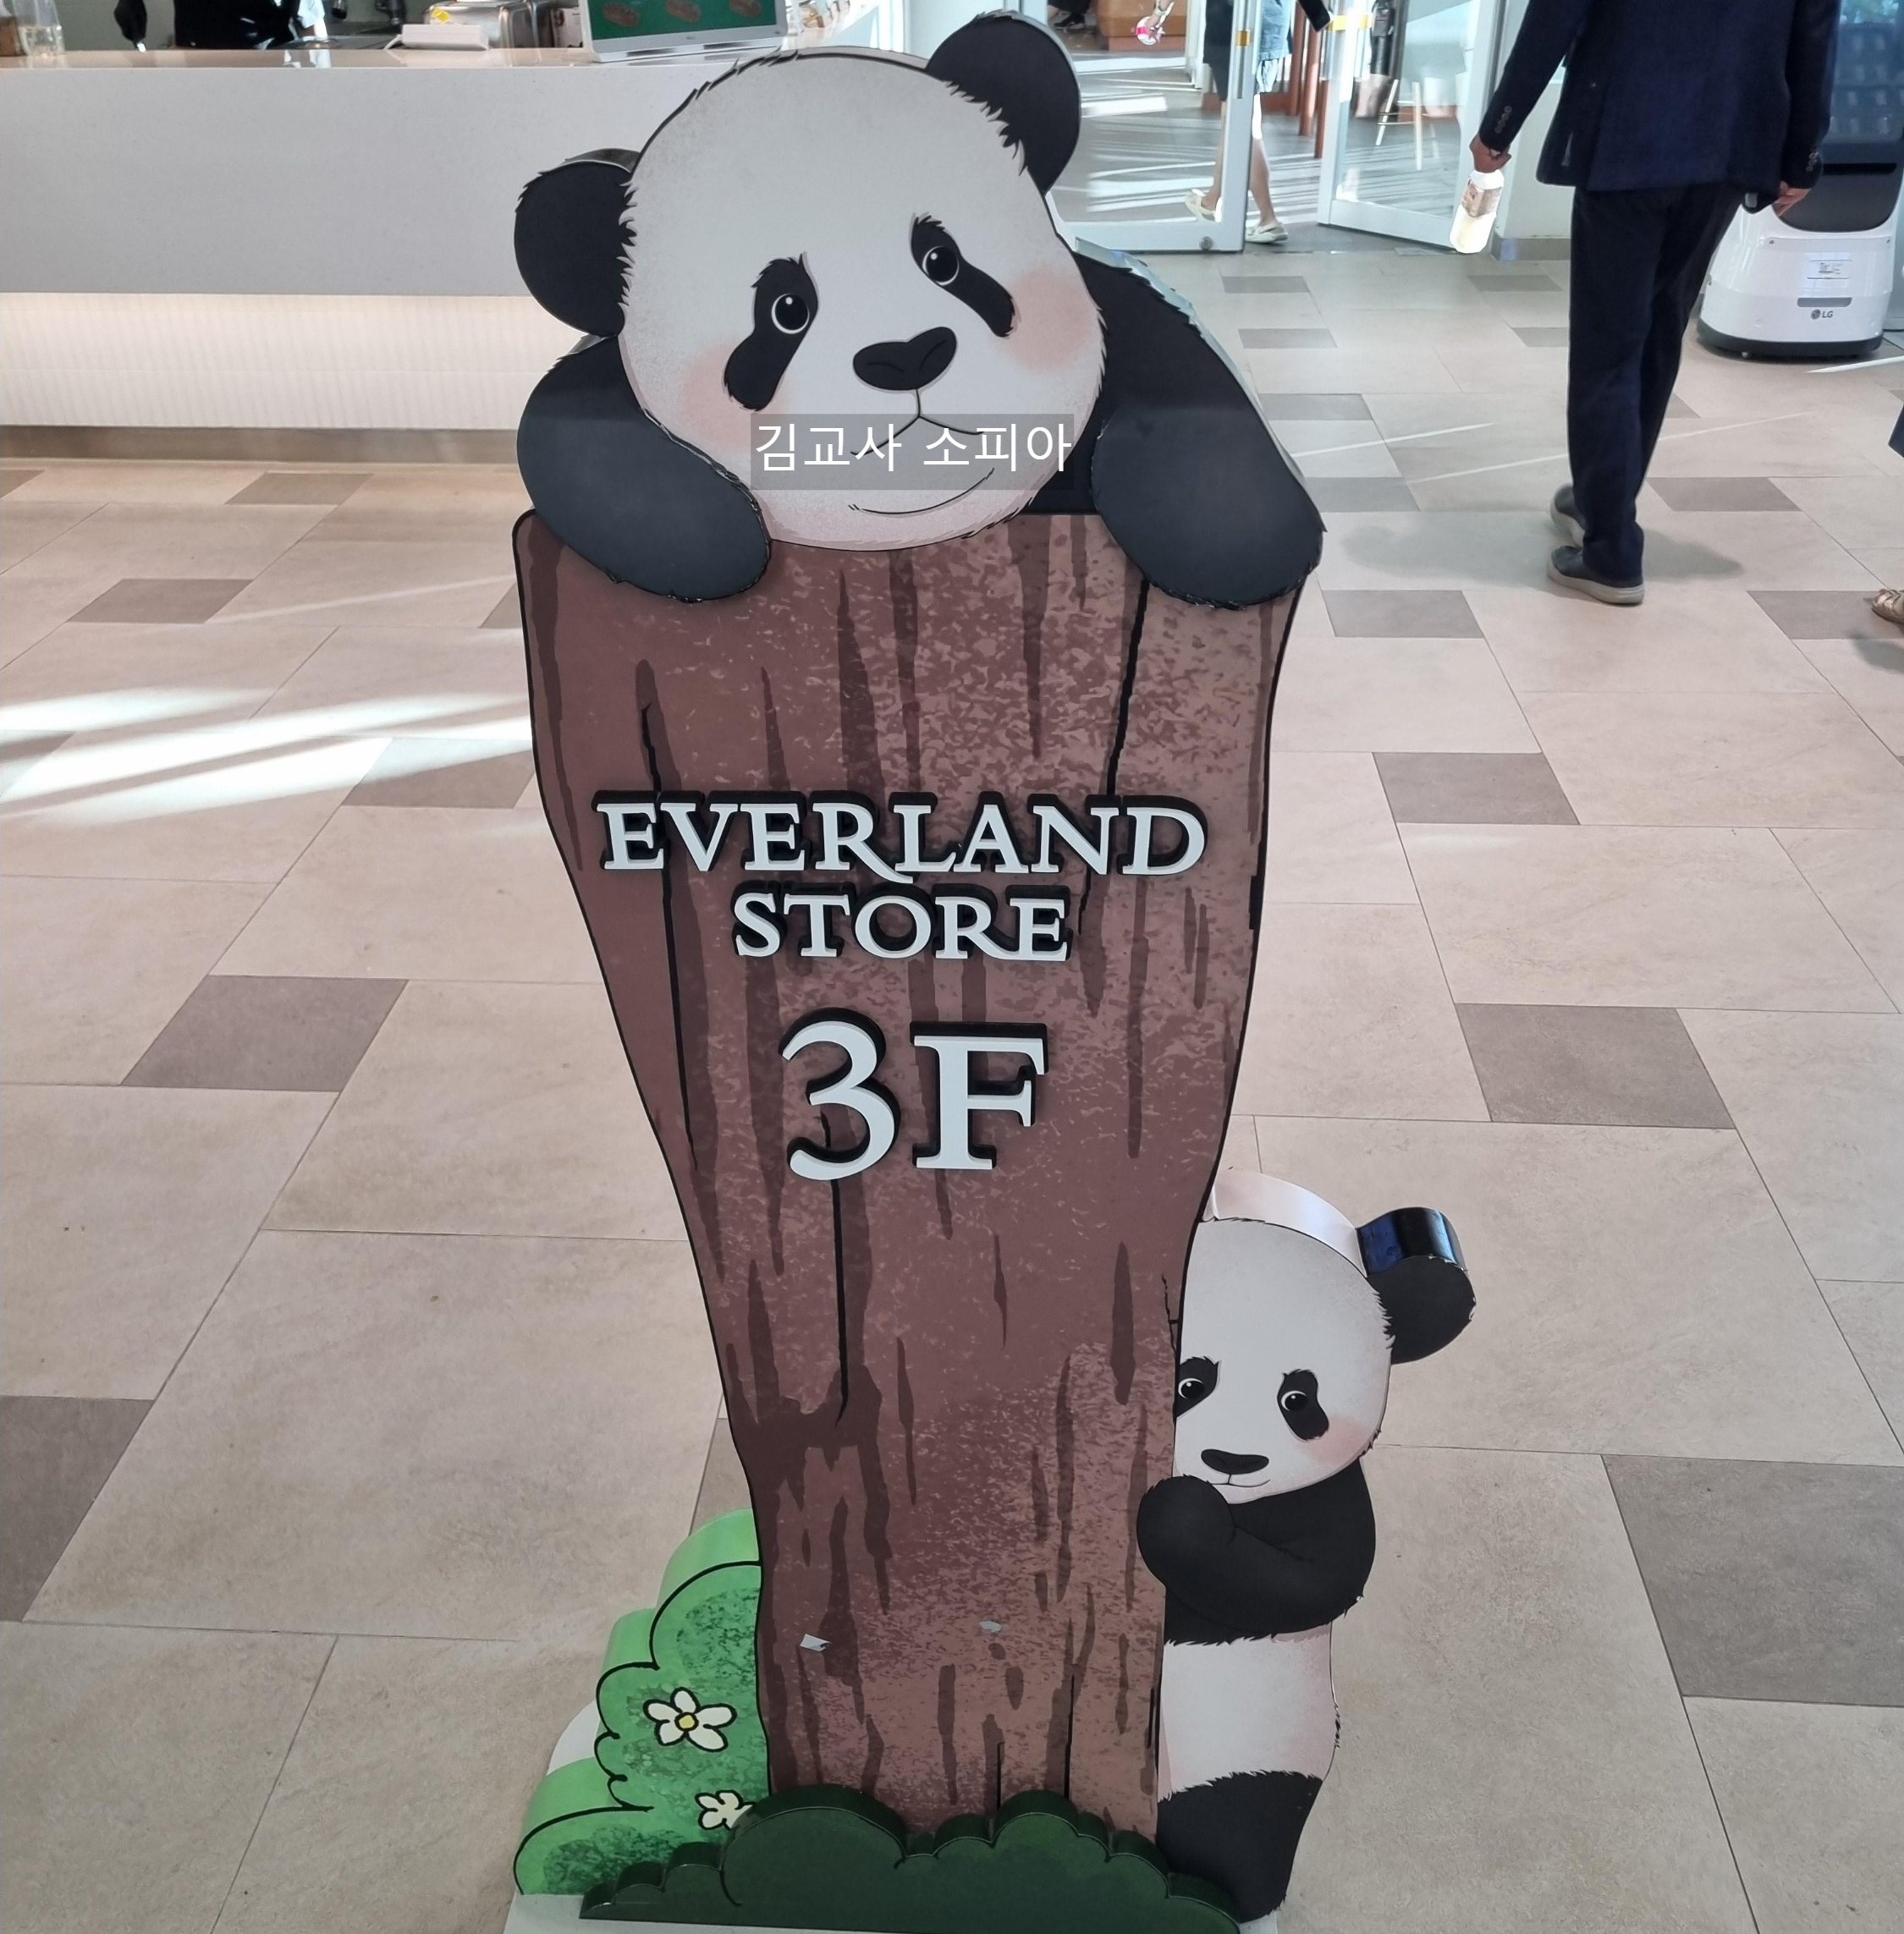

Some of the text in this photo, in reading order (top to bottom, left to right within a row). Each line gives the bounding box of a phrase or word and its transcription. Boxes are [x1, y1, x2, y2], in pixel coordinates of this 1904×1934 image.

[595, 802, 1206, 883] EVERLAND
[732, 893, 1069, 962] STORE
[781, 1020, 1047, 1181] 3F
